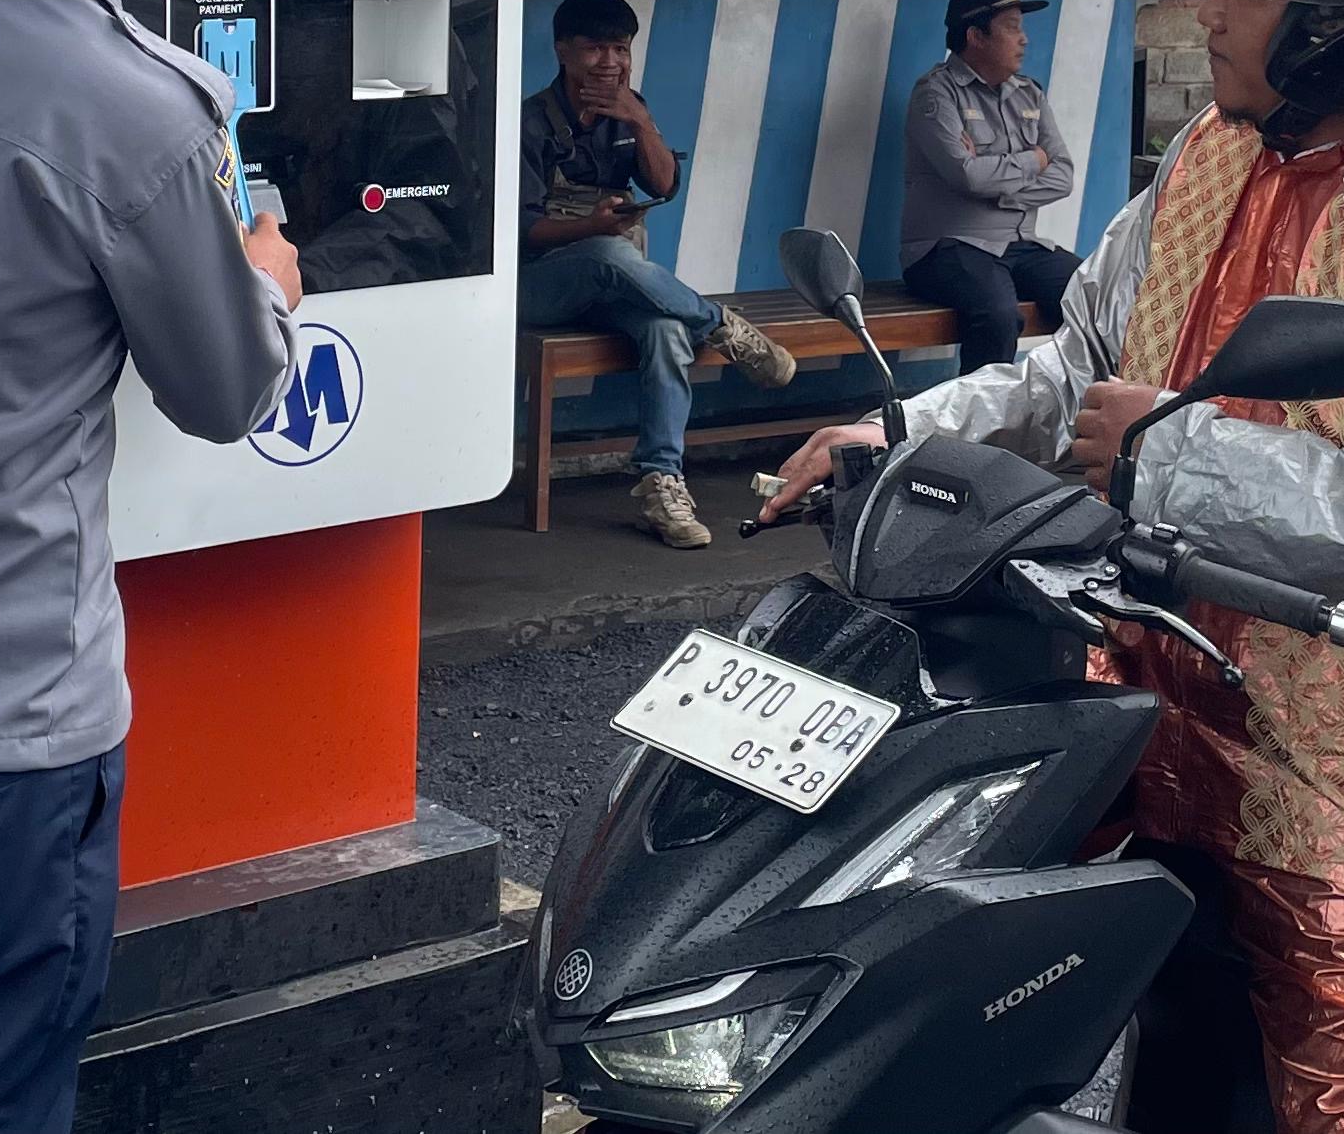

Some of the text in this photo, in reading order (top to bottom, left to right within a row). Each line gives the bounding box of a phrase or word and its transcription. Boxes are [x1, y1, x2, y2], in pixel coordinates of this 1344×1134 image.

[198, 3, 244, 15] PAYMENT
[385, 183, 451, 199] EMERGENCY
[910, 480, 958, 505] HONDA
[663, 642, 702, 678] P
[703, 658, 797, 719] 3970
[982, 951, 1087, 1024] HONDA
